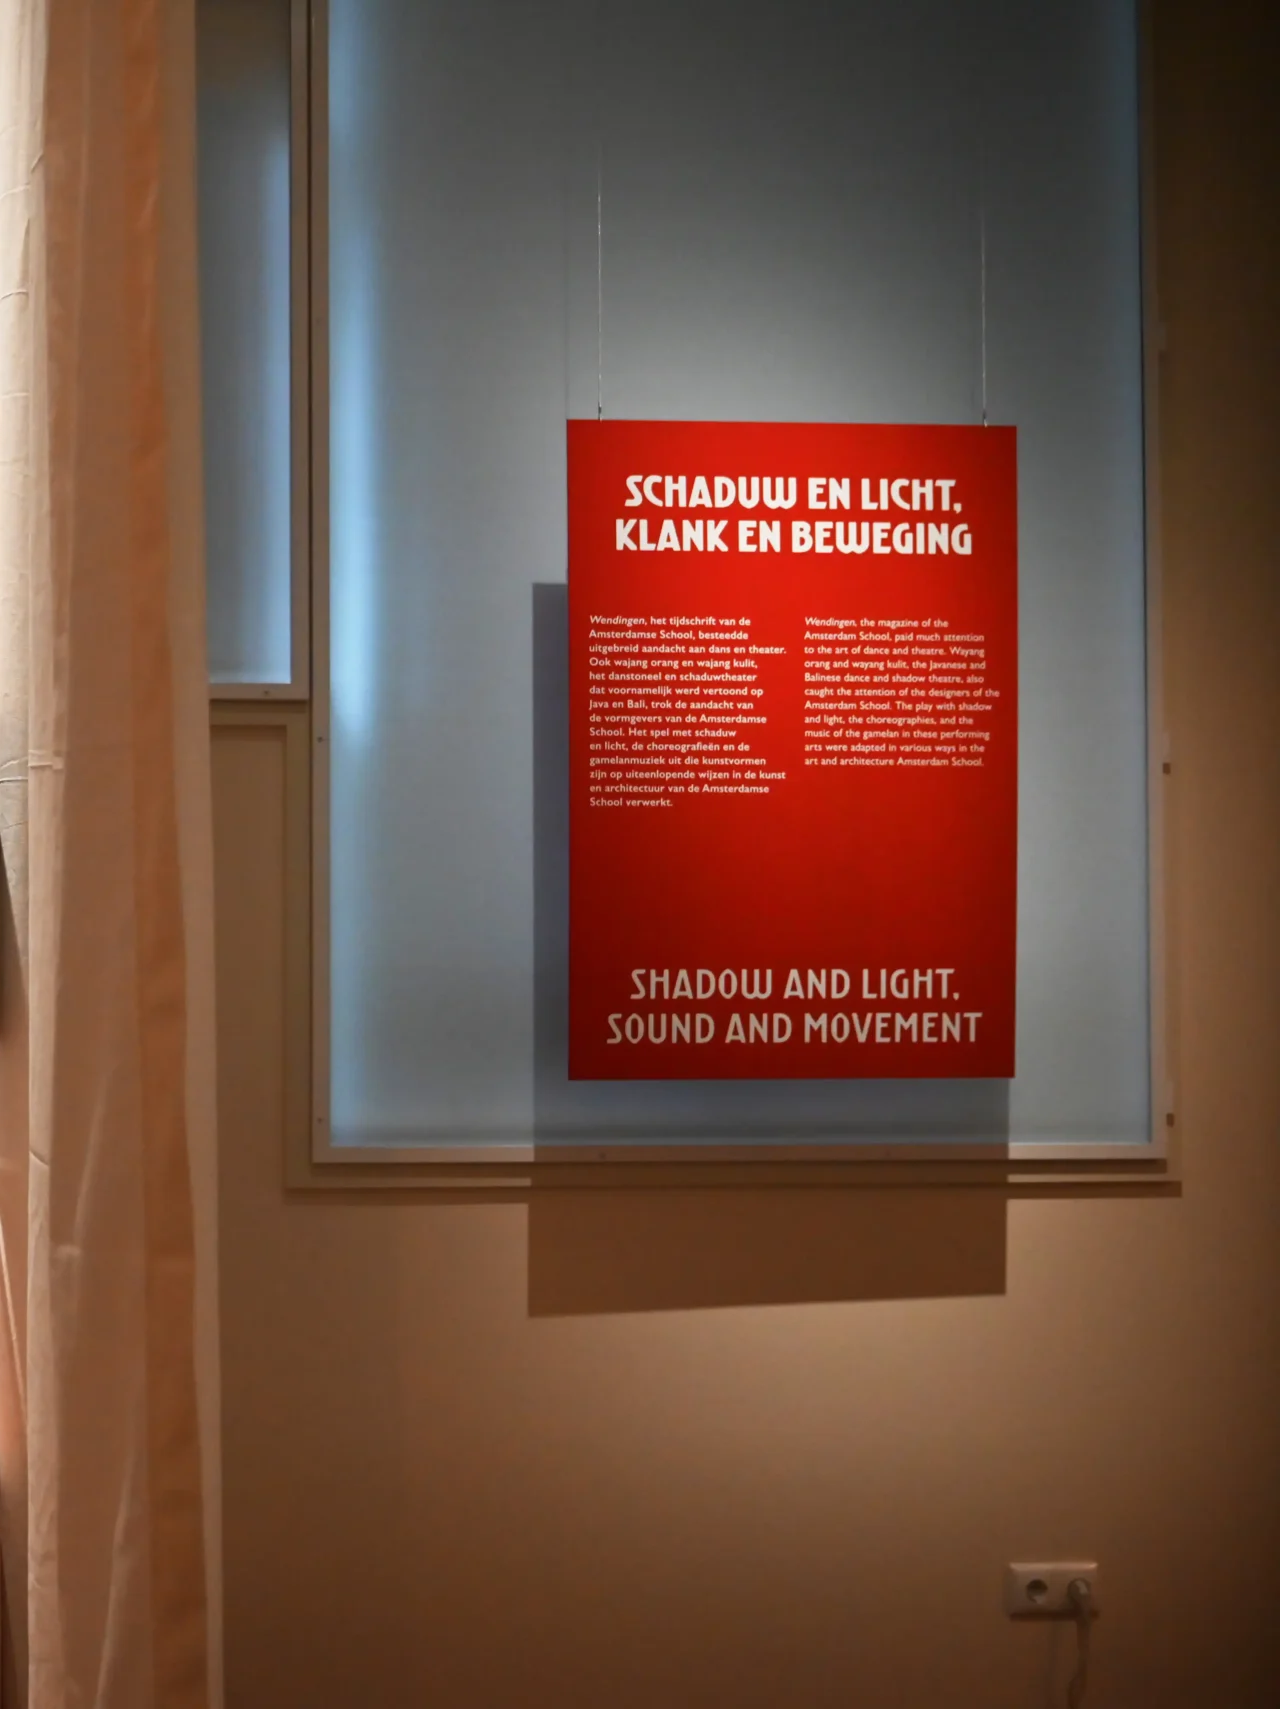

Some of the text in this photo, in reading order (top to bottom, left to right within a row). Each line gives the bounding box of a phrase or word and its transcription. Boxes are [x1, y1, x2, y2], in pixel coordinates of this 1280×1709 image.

[624, 474, 963, 514] SCHADUW EN LICHT,
[615, 518, 973, 556] KLANK EN BEWEGING
[589, 615, 752, 628] Wendingen, het tijdschrift van de
[859, 617, 876, 628] the
[877, 619, 920, 630] magazine
[921, 617, 932, 628] of
[933, 618, 949, 628] the
[588, 628, 749, 641] Amsterdamse School, besteedde
[803, 630, 857, 641] Amsterdam
[894, 631, 914, 644] paid
[915, 632, 941, 642] much
[943, 633, 985, 642] attention
[588, 643, 787, 655] uitgebreid aandacht aan dans en theater.
[803, 646, 816, 655] to
[816, 644, 833, 655] the
[834, 646, 849, 655] art
[850, 644, 862, 655] of
[862, 644, 891, 656] dance
[891, 645, 910, 656] and
[949, 645, 985, 659] Wayang
[588, 656, 759, 671] Ook wajang orang en wajang kulit,
[803, 660, 831, 671] orang
[832, 658, 850, 669] and
[851, 660, 885, 672] wayang
[911, 659, 928, 670] the
[928, 659, 968, 672] Javanese
[969, 660, 987, 670] and
[588, 670, 758, 682] het danstoneel en schaduwtheater
[589, 684, 764, 699] dat voornamelijk werd vertoond op
[630, 967, 960, 1001] SHADOW AND LIGHT,
[606, 1011, 983, 1045] SOUND AND MOVEMENT
